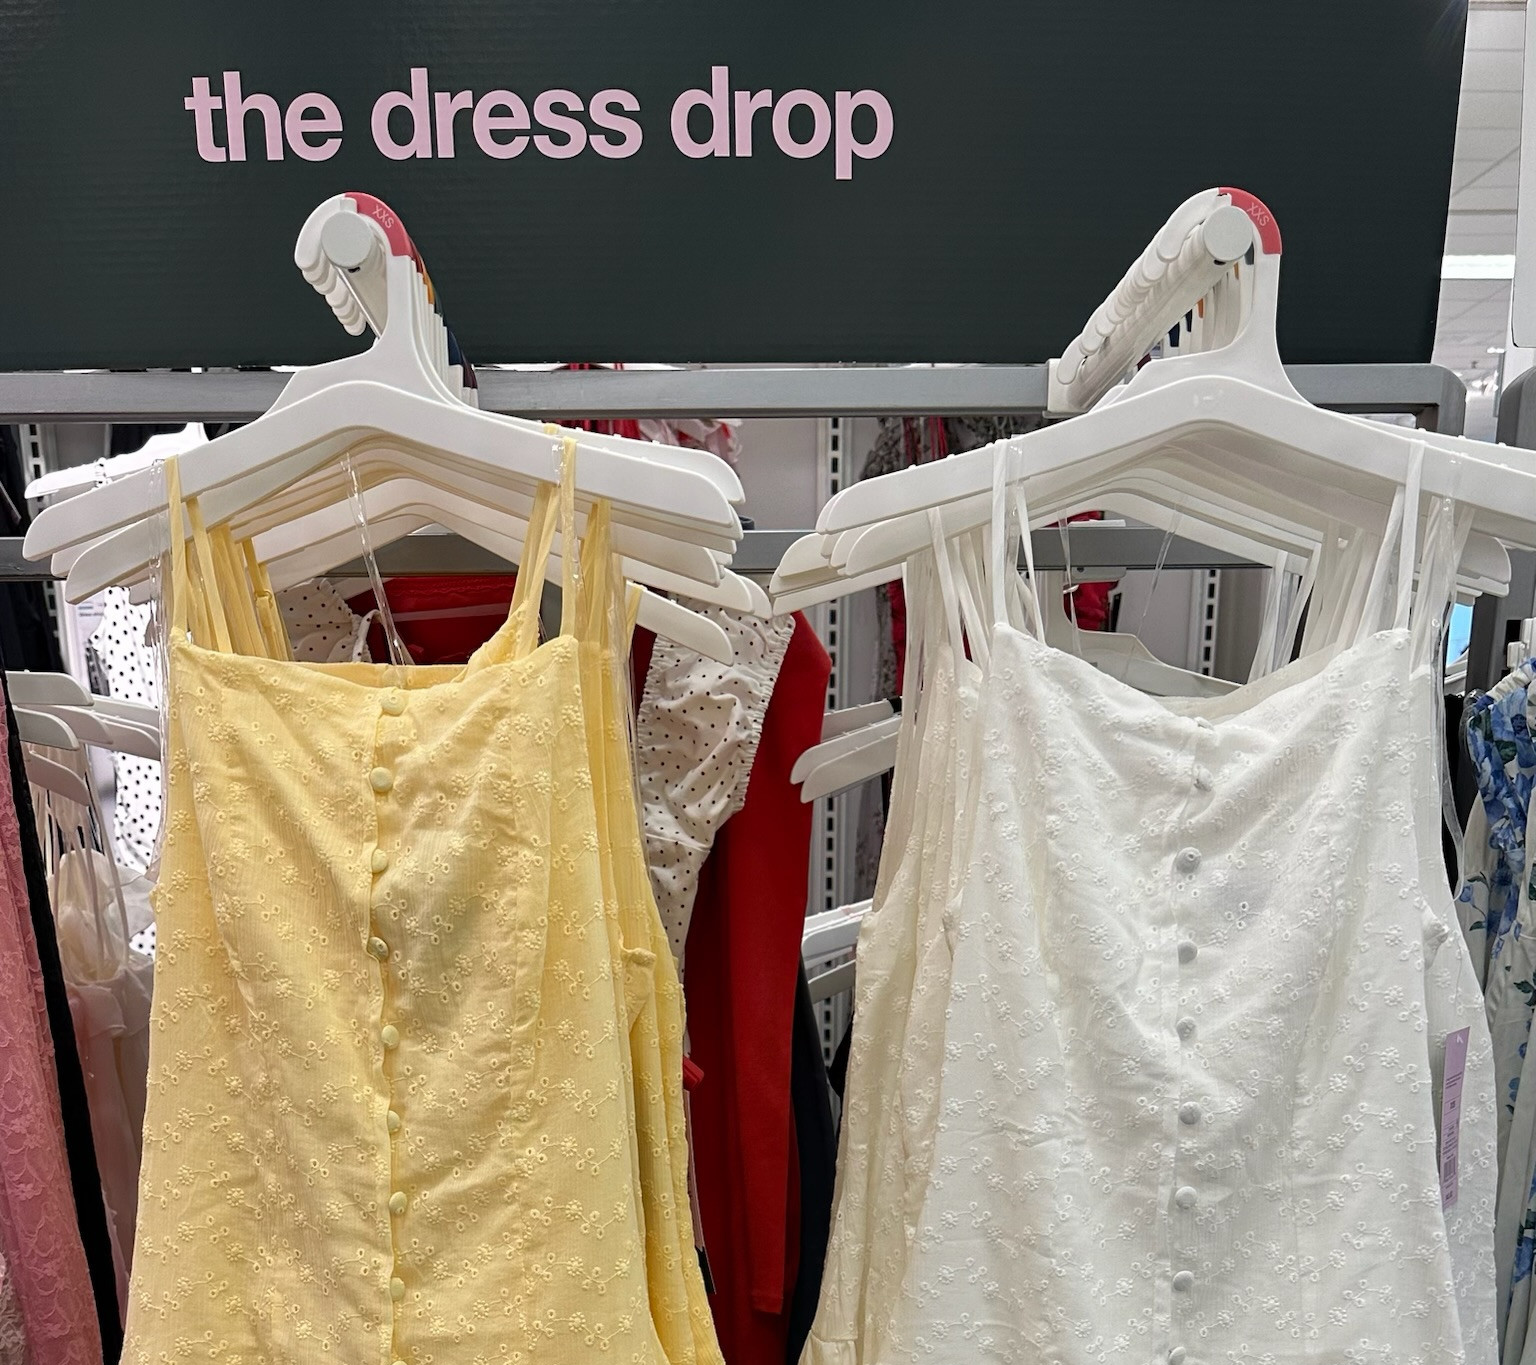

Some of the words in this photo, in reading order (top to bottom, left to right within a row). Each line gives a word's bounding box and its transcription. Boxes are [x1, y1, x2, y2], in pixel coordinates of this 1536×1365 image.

[184, 71, 343, 162] the
[371, 67, 643, 160] dress
[671, 65, 894, 180] drop
[372, 204, 395, 229] XXS
[1246, 202, 1270, 227] XXS
